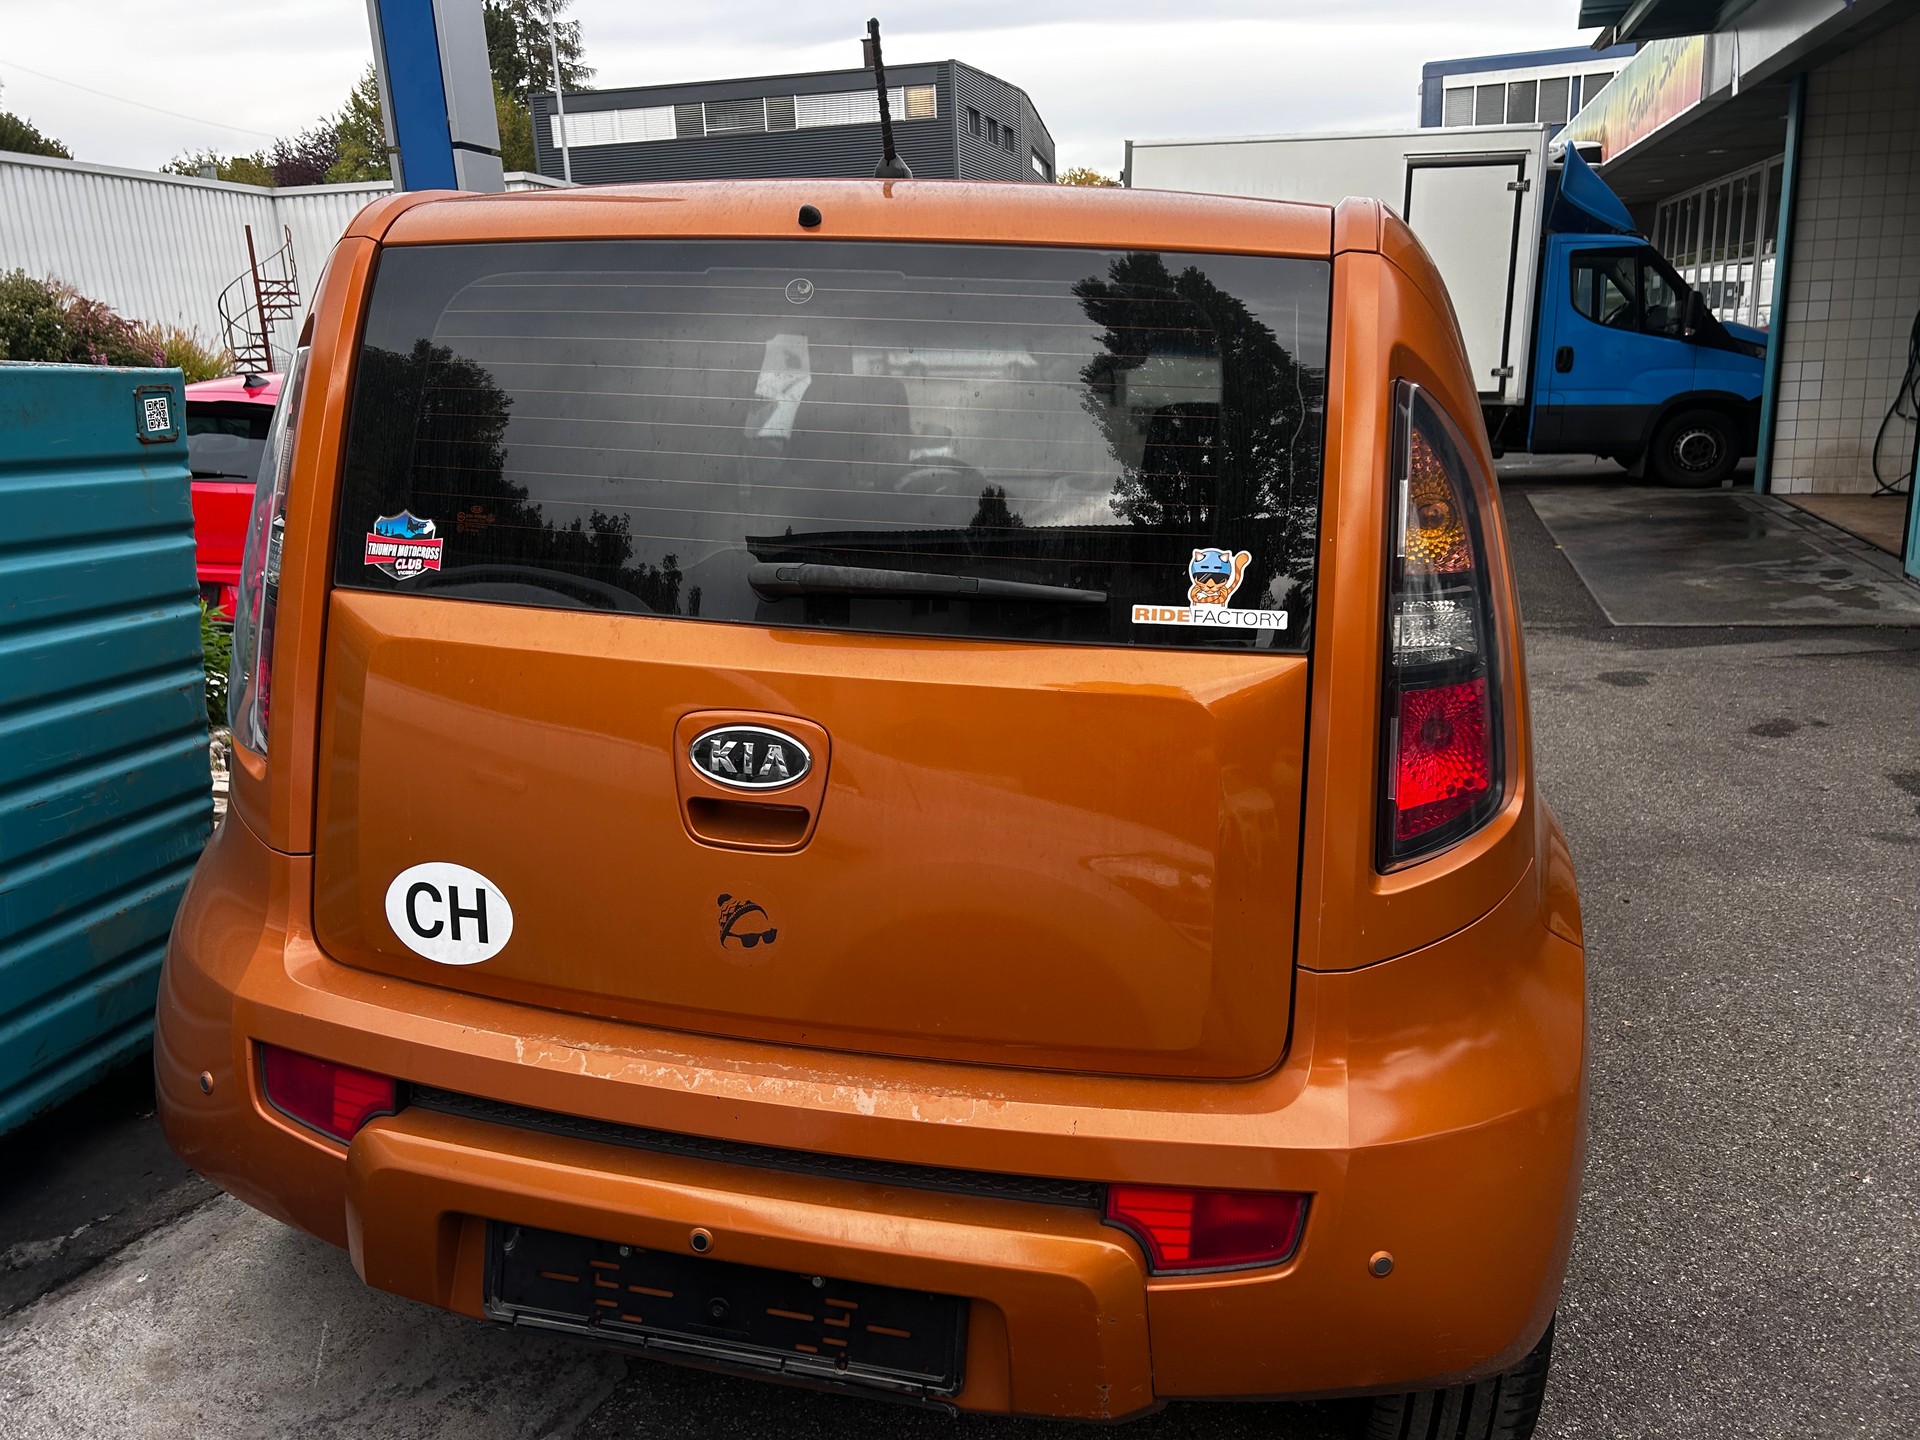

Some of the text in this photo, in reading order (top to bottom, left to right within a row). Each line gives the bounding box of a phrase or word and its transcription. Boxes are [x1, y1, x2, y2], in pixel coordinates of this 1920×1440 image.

[367, 542, 440, 561] TRIUMPH MOTOCROSS
[394, 558, 423, 571] CLUB
[709, 738, 790, 778] KIA
[405, 881, 489, 944] CH
